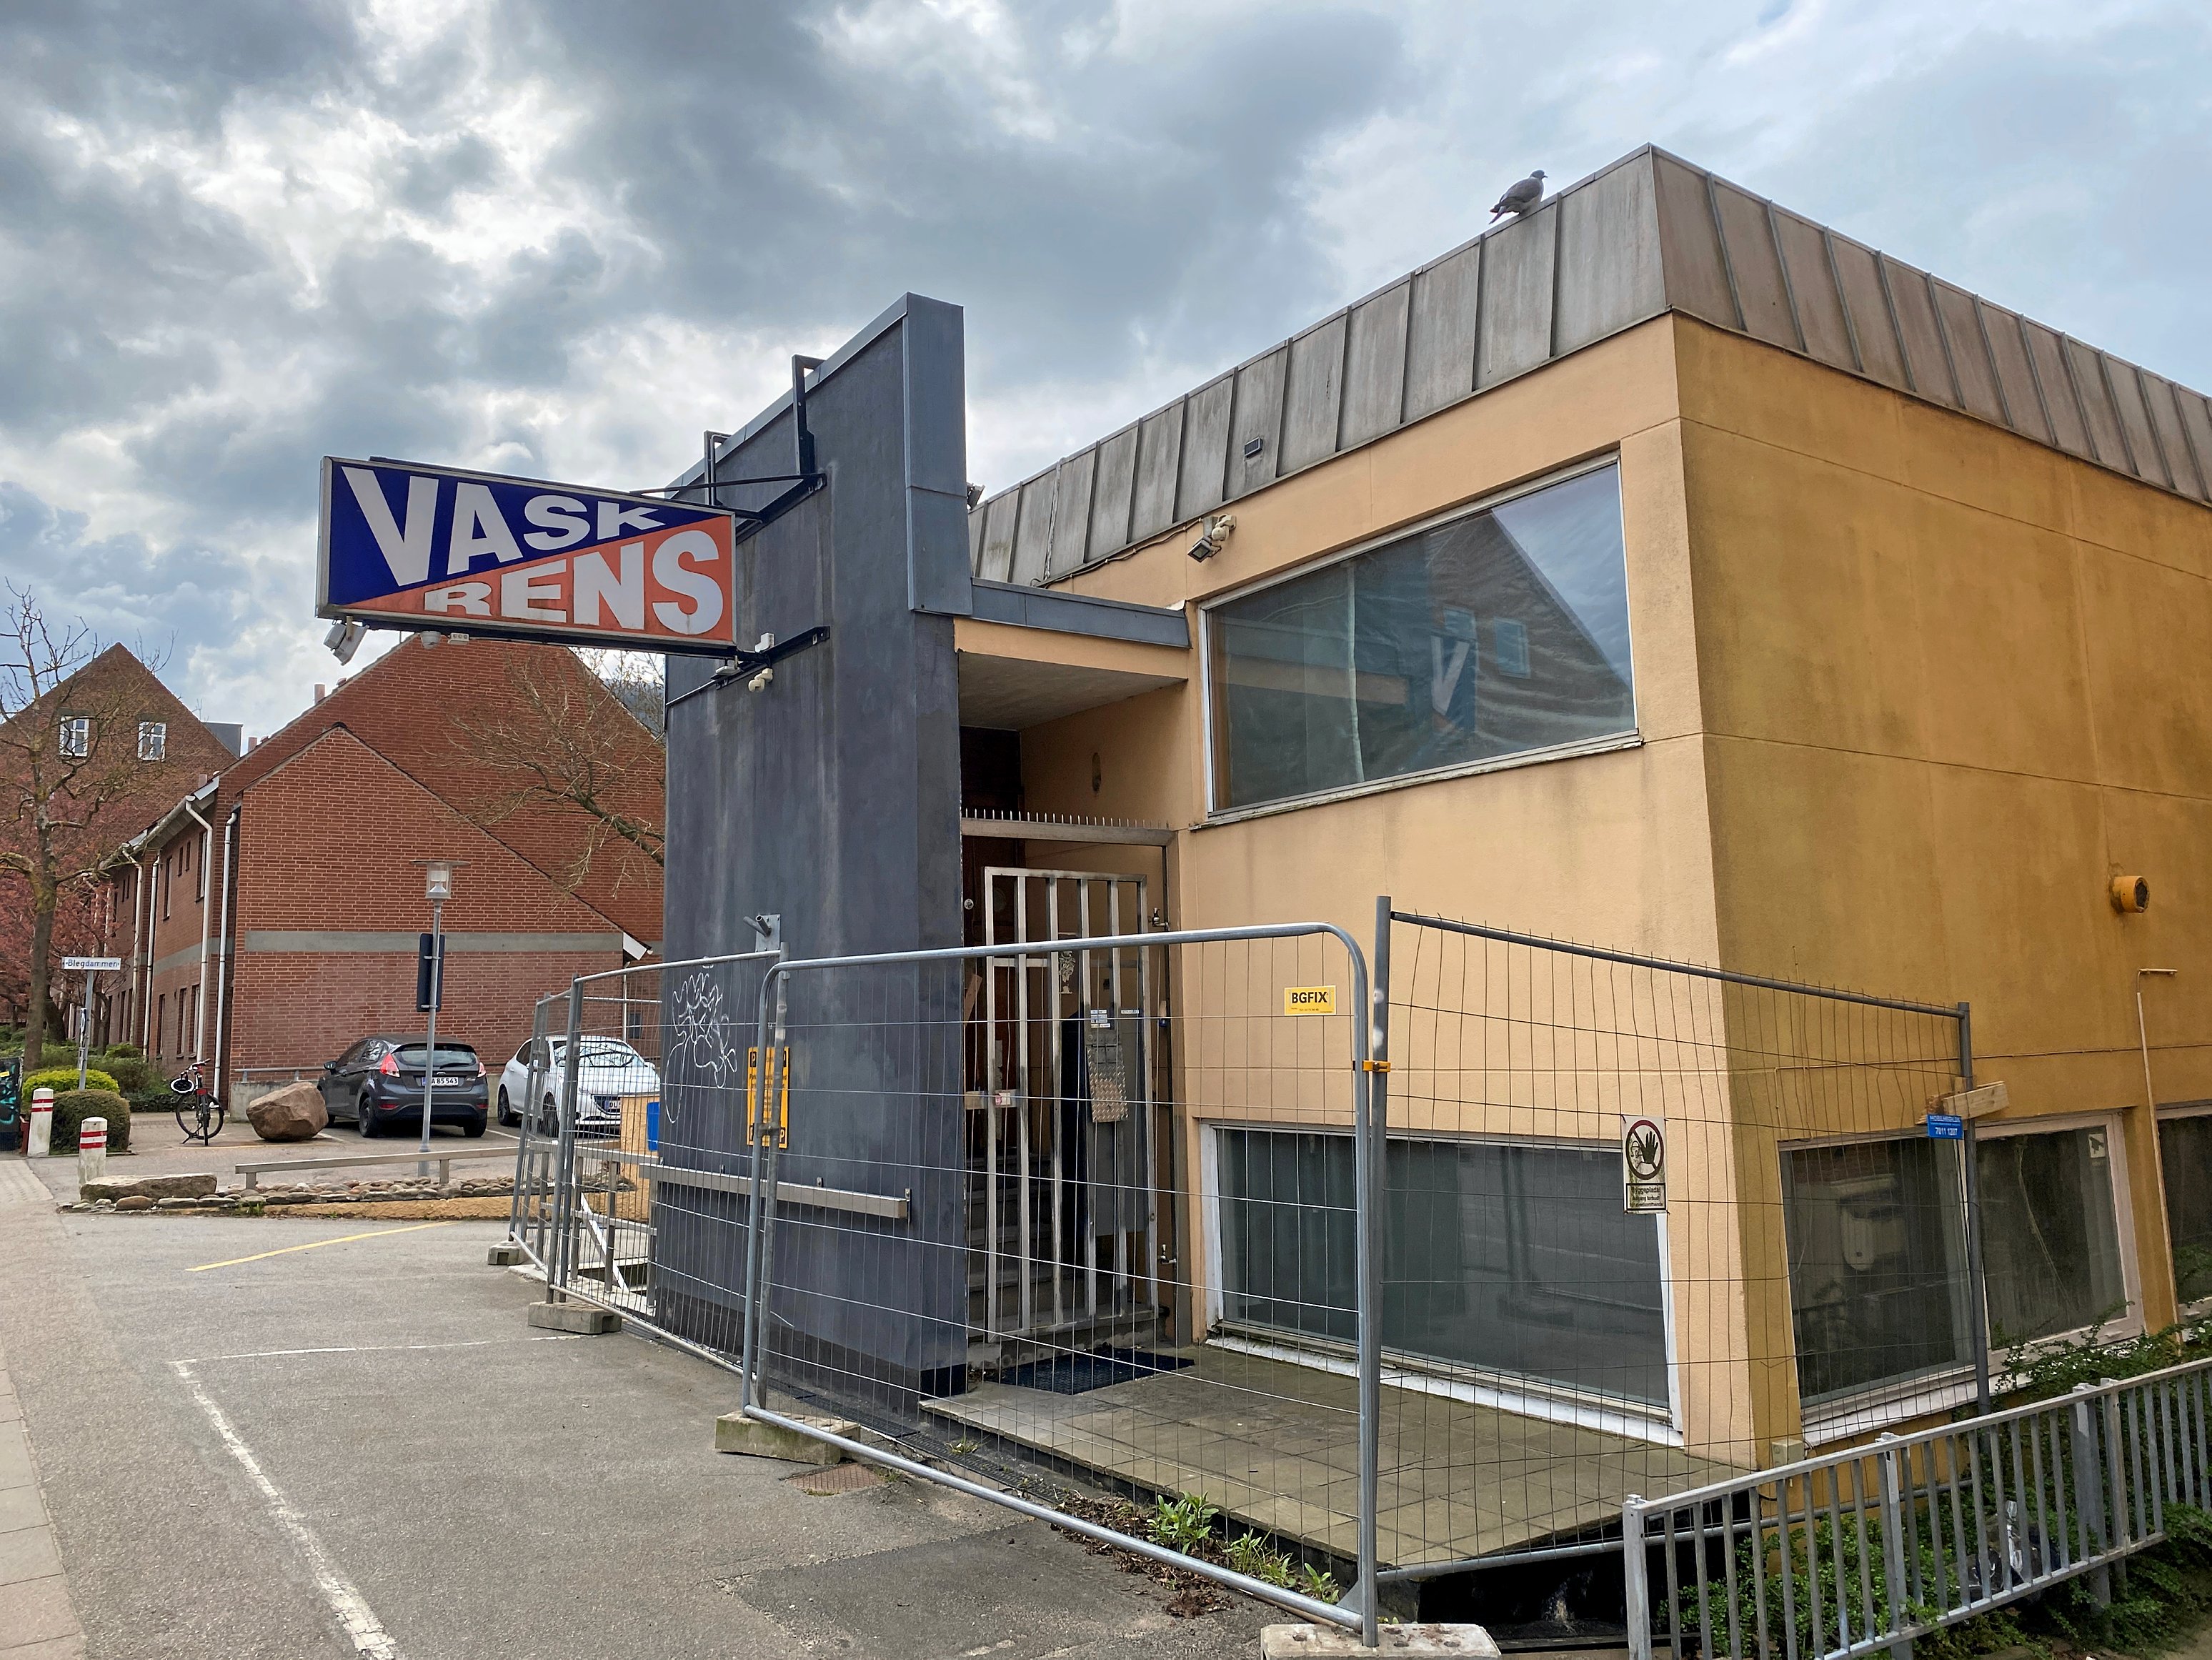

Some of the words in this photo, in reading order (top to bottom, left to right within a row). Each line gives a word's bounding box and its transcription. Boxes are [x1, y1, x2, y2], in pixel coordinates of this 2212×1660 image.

[342, 467, 666, 587] VASK
[424, 530, 723, 635] RENS
[68, 959, 117, 968] Blegdammen
[1292, 991, 1327, 1003] BGFIX
